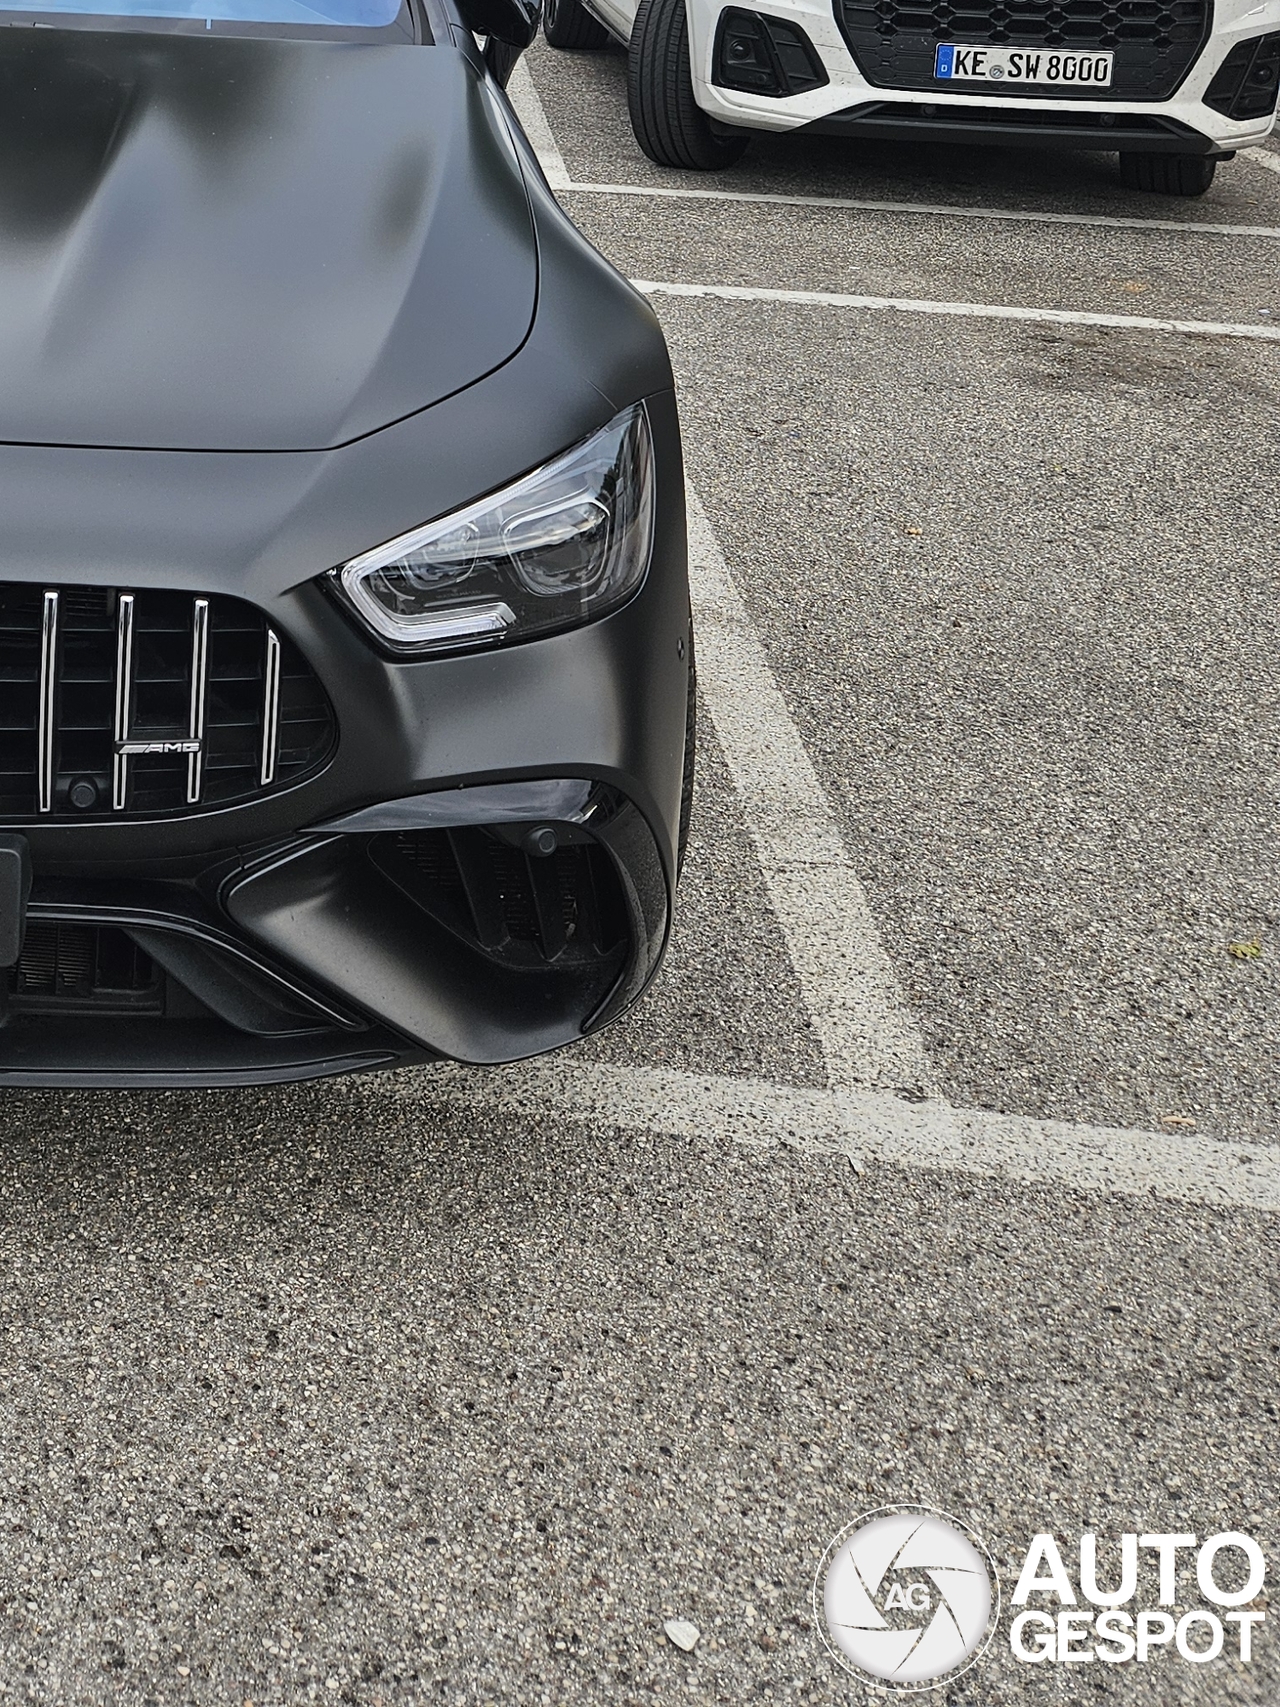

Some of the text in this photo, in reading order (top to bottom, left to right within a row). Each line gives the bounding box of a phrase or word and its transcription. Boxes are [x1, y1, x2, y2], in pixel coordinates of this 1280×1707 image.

[954, 50, 1108, 82] KE SW 8000
[144, 742, 200, 753] AMG
